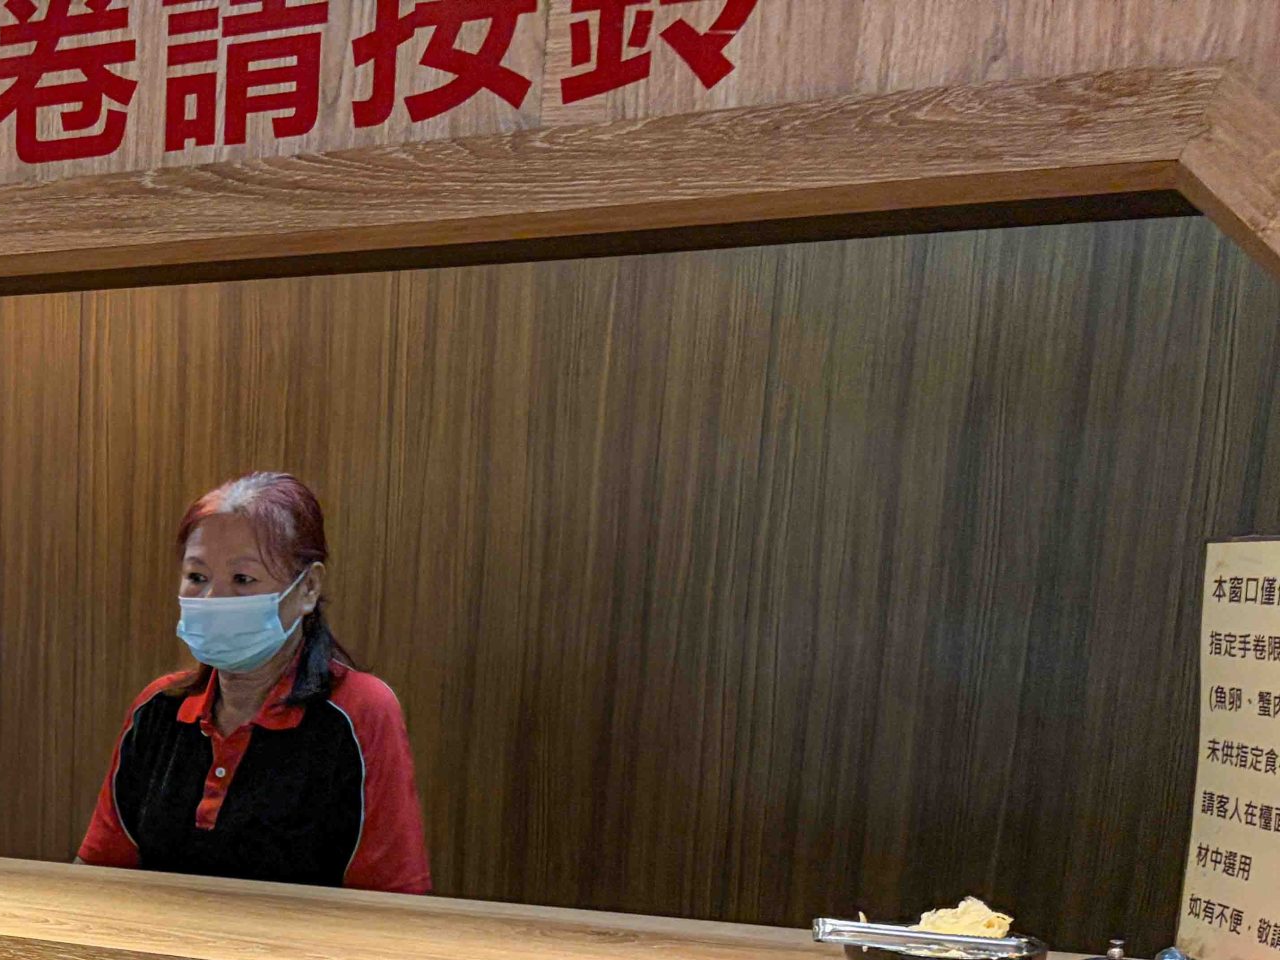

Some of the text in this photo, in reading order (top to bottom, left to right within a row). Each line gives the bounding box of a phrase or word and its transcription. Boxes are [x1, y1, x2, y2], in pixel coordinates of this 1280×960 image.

[1212, 575, 1280, 606] 本窗口僅
[1206, 738, 1280, 776] 未供指定食
[1196, 842, 1253, 882] 材中選用
